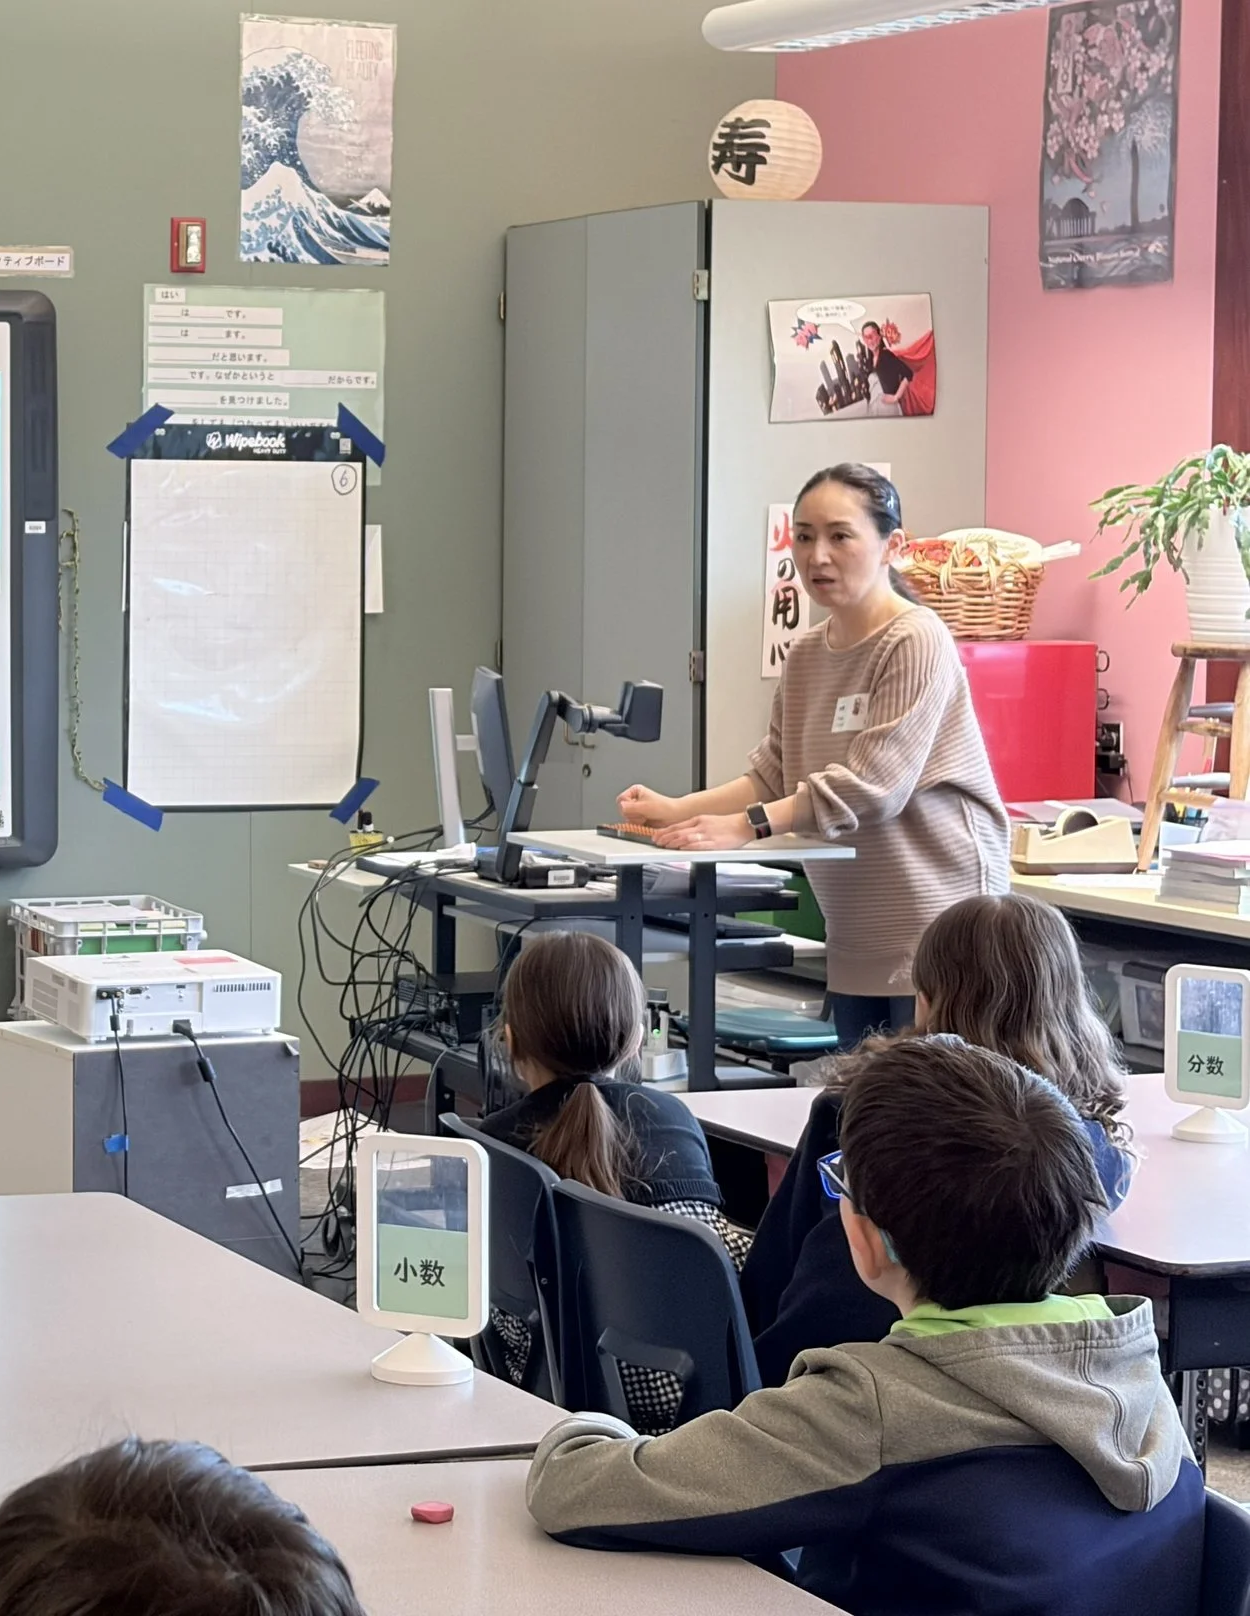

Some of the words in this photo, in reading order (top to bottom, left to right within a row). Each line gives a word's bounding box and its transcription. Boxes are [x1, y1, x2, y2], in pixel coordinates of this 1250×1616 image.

[711, 117, 771, 186] 寿
[161, 291, 179, 299] はい
[181, 308, 190, 317] は
[180, 329, 189, 337] は
[225, 432, 286, 451] Wipebook
[1187, 1054, 1225, 1076] 分数
[394, 1257, 445, 1287] 小数
